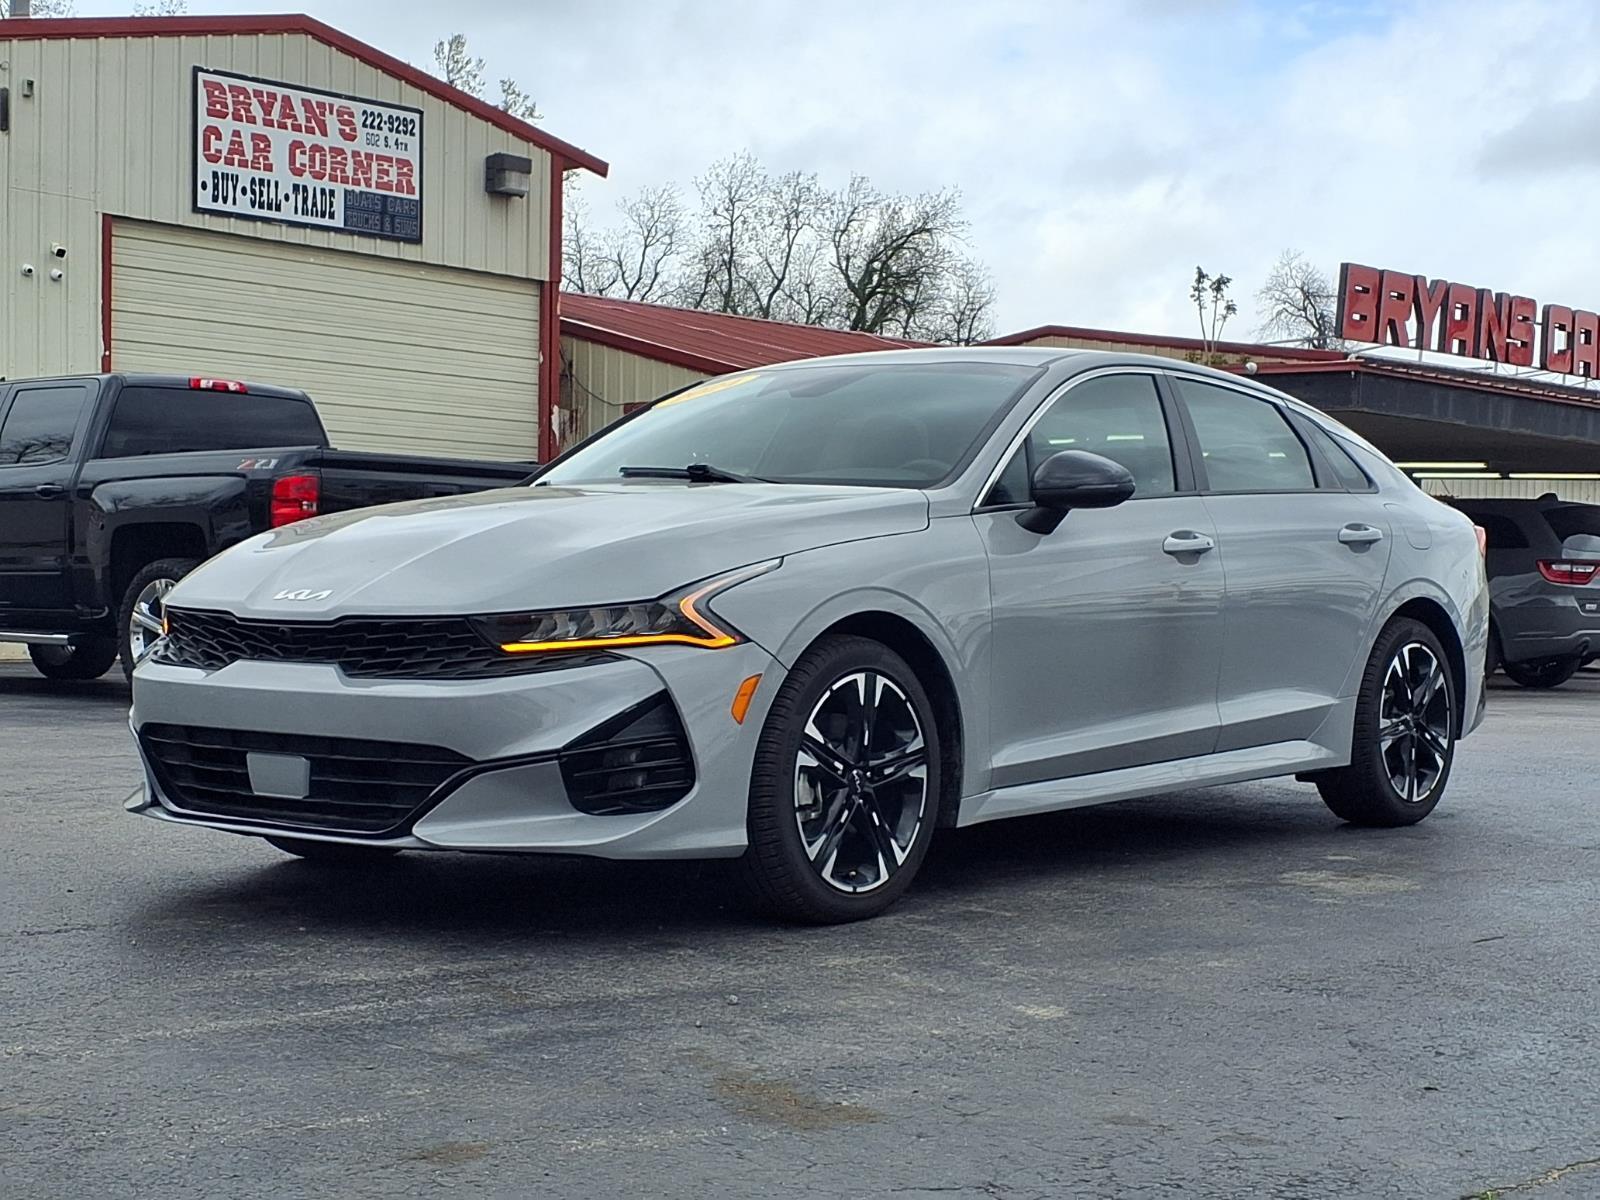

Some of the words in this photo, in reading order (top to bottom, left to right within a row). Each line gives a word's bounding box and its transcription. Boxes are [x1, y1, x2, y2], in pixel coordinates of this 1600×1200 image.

[202, 79, 359, 142] BRYAN'S
[361, 109, 416, 138] 222-9292
[202, 125, 274, 173] CAR
[288, 139, 416, 195] CORNER
[365, 132, 381, 147] 602
[211, 170, 239, 206] BUY
[250, 176, 282, 212] SELL
[292, 183, 336, 220] TRADE
[387, 197, 417, 216] CARS
[1335, 262, 1538, 367] BRYANS
[1541, 303, 1600, 379] CA
